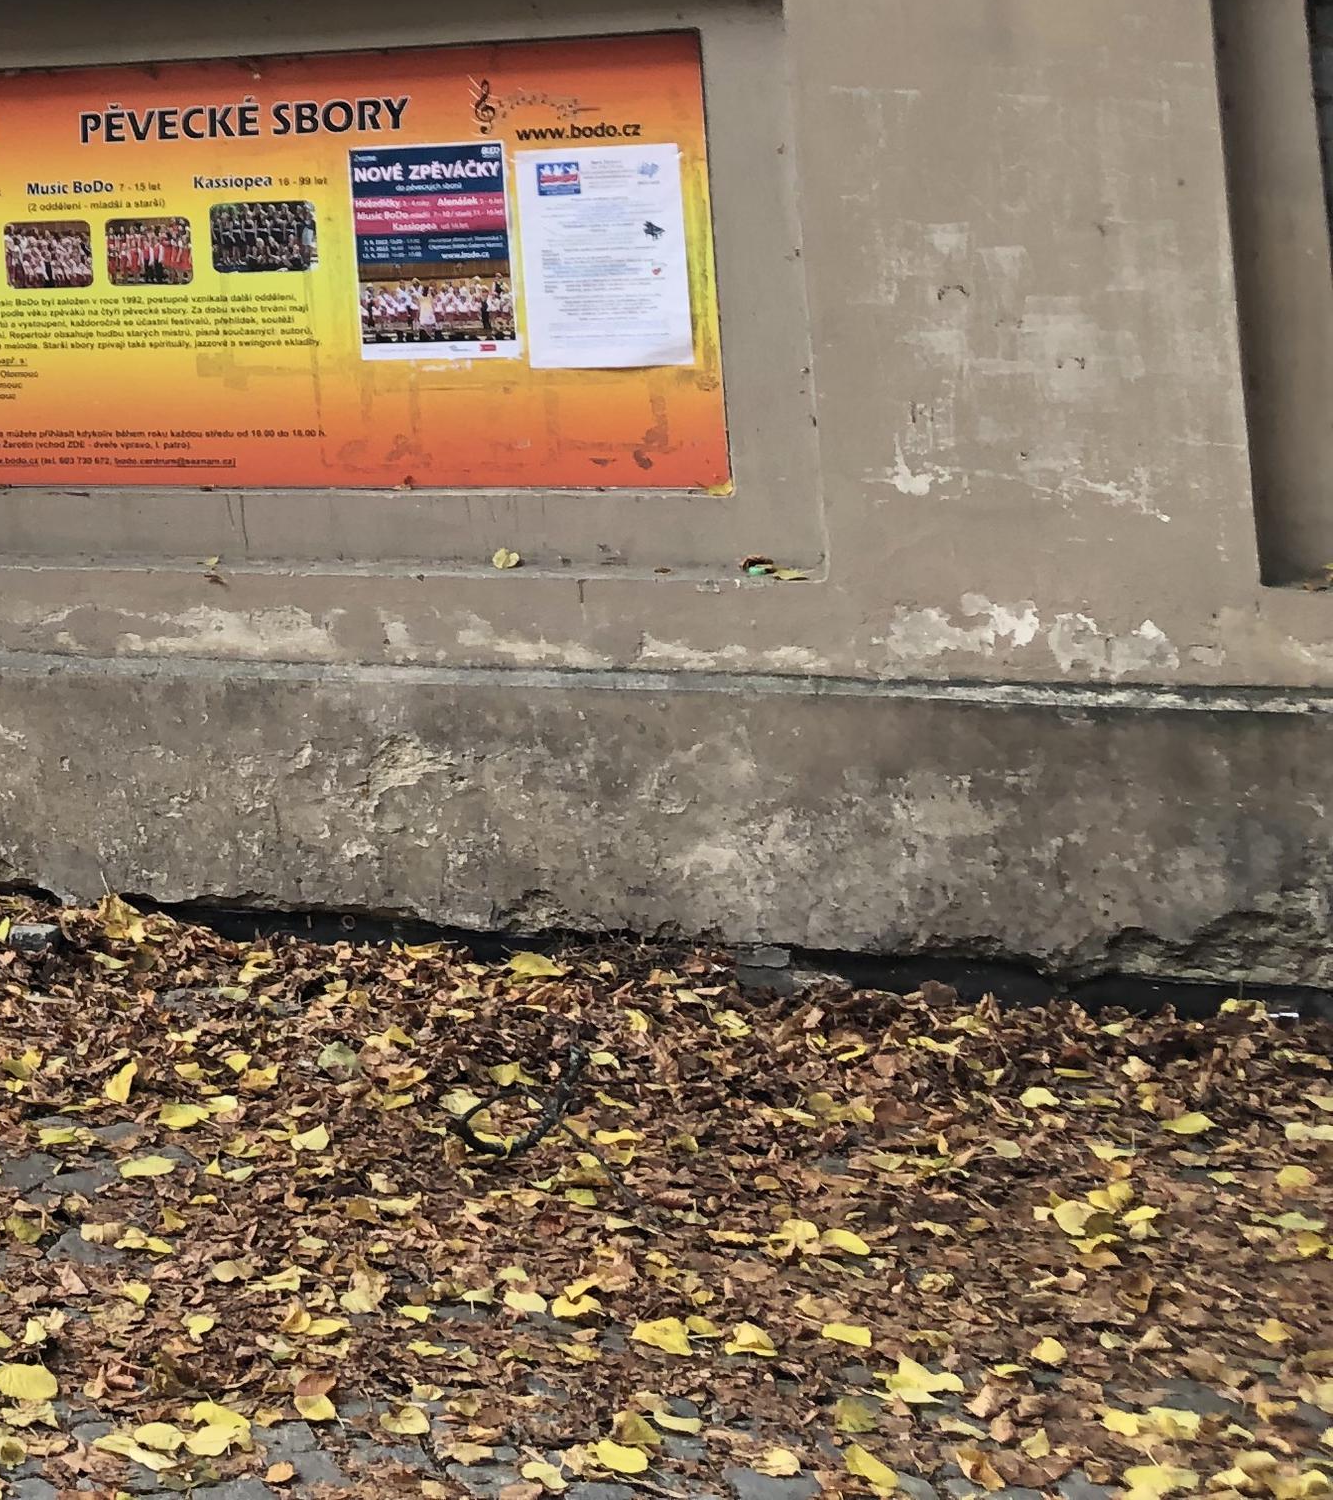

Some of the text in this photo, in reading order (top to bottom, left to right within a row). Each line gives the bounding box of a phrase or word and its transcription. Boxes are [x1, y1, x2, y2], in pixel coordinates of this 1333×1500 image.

[80, 96, 409, 143] PĚVECKÉ SBORY
[515, 122, 641, 141] www.bodo.cz
[353, 159, 501, 183] NOVÉ ZPĚVÁČKY
[27, 181, 68, 196] Music
[73, 180, 113, 194] BoDo
[148, 182, 161, 191] let
[193, 175, 272, 190] Kassiopea
[314, 176, 328, 185] let
[90, 200, 121, 210] mladší
[0, 370, 39, 378] Olomouc
